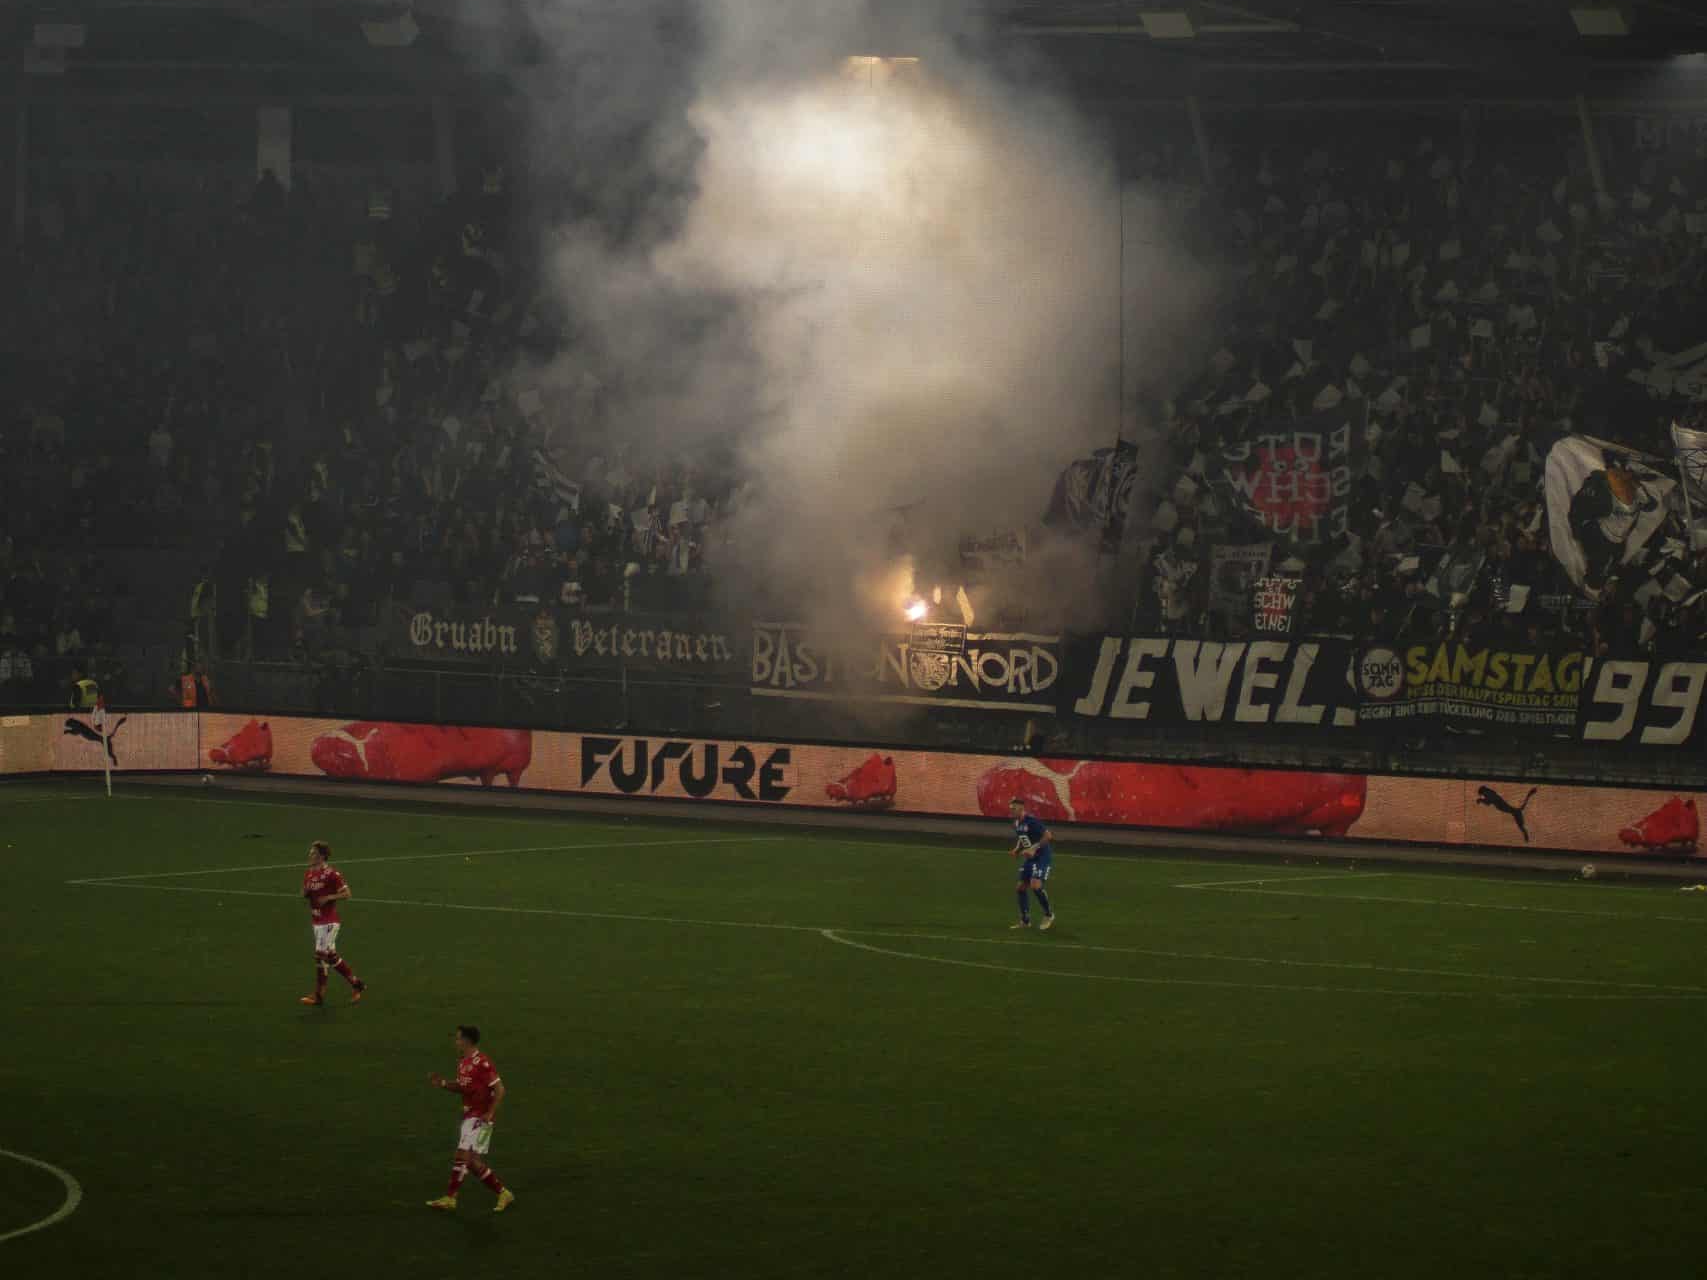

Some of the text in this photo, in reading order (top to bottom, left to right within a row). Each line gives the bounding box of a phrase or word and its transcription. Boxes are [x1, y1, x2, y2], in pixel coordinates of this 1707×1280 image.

[409, 611, 732, 662] Gruabn Veteranen
[950, 646, 1059, 696] NORD
[1368, 675, 1395, 688] TAG
[1405, 641, 1584, 692] SAMSTAG
[581, 736, 792, 802] FUTURE
